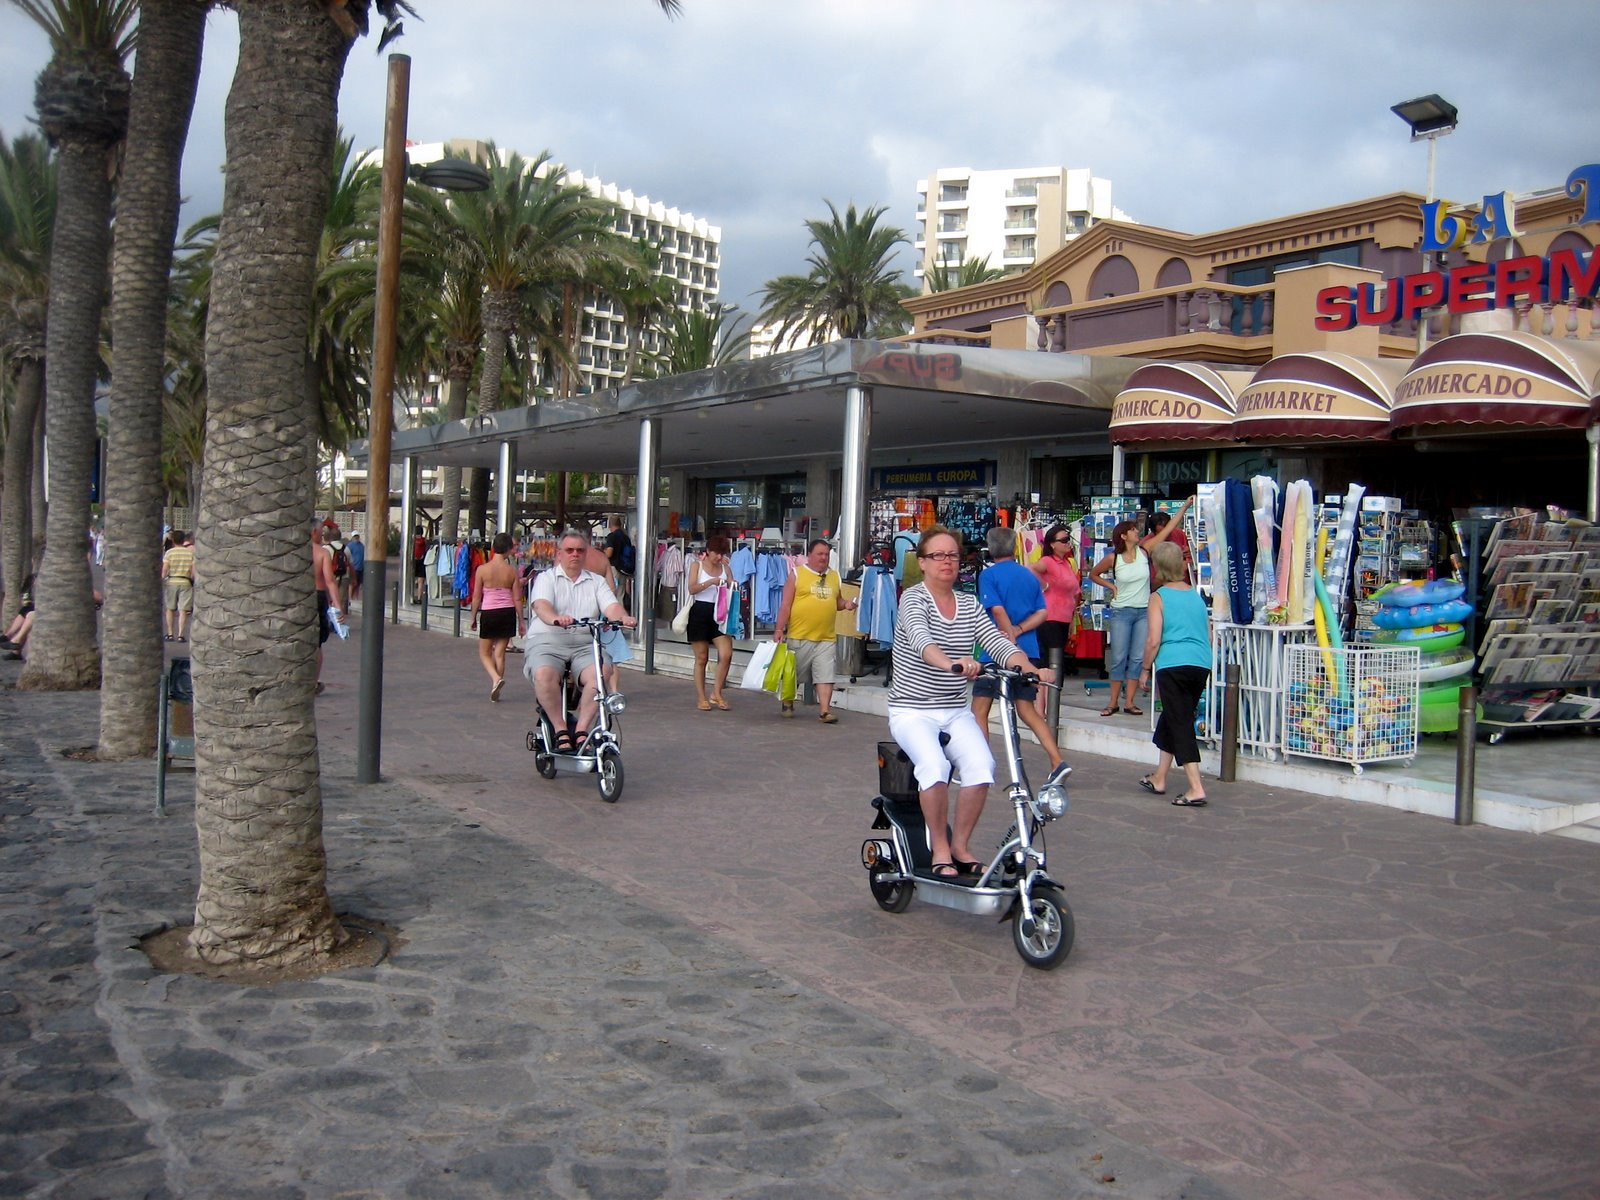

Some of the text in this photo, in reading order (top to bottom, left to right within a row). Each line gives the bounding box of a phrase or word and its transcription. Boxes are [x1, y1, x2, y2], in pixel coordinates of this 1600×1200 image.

[1418, 190, 1518, 253] LA
[1314, 244, 1600, 332] SUPERM
[886, 470, 978, 483] PERFUMERIA EUROPA
[1157, 461, 1200, 480] BOSS
